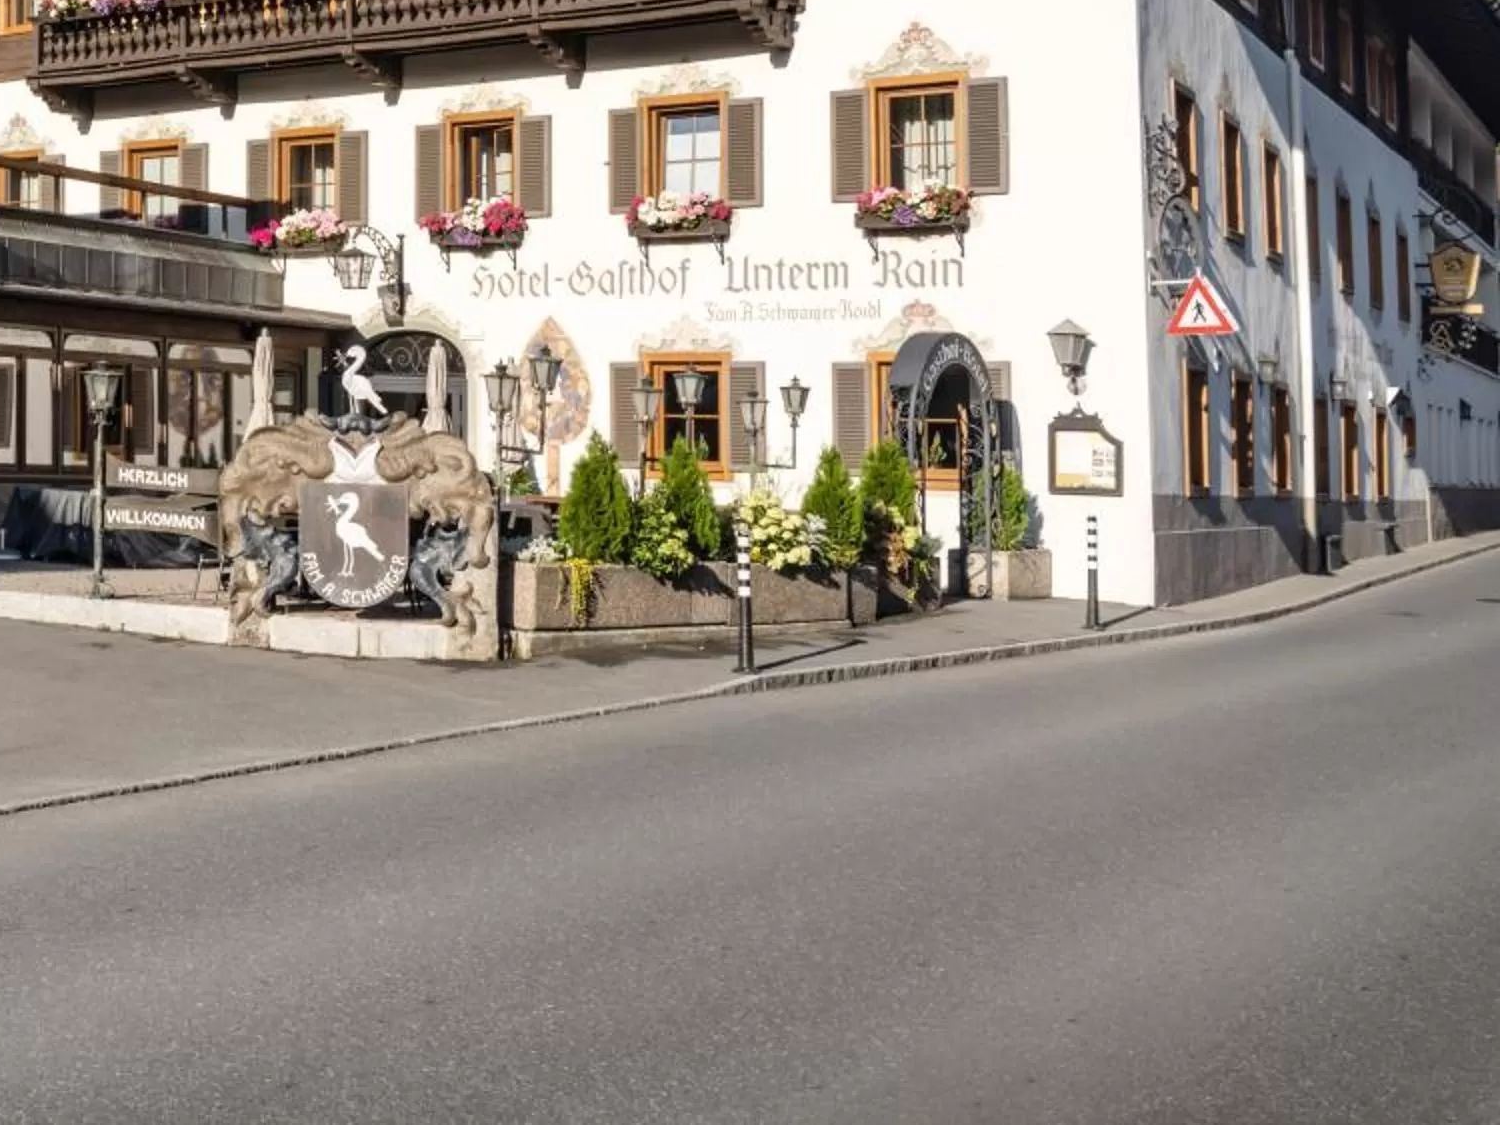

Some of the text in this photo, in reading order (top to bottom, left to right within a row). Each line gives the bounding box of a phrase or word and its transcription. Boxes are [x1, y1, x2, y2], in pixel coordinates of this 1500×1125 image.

[724, 255, 849, 293] Unterm
[871, 249, 964, 289] Rain
[117, 466, 189, 489] HERZLICH
[105, 507, 206, 531] WILLKOMMEN
